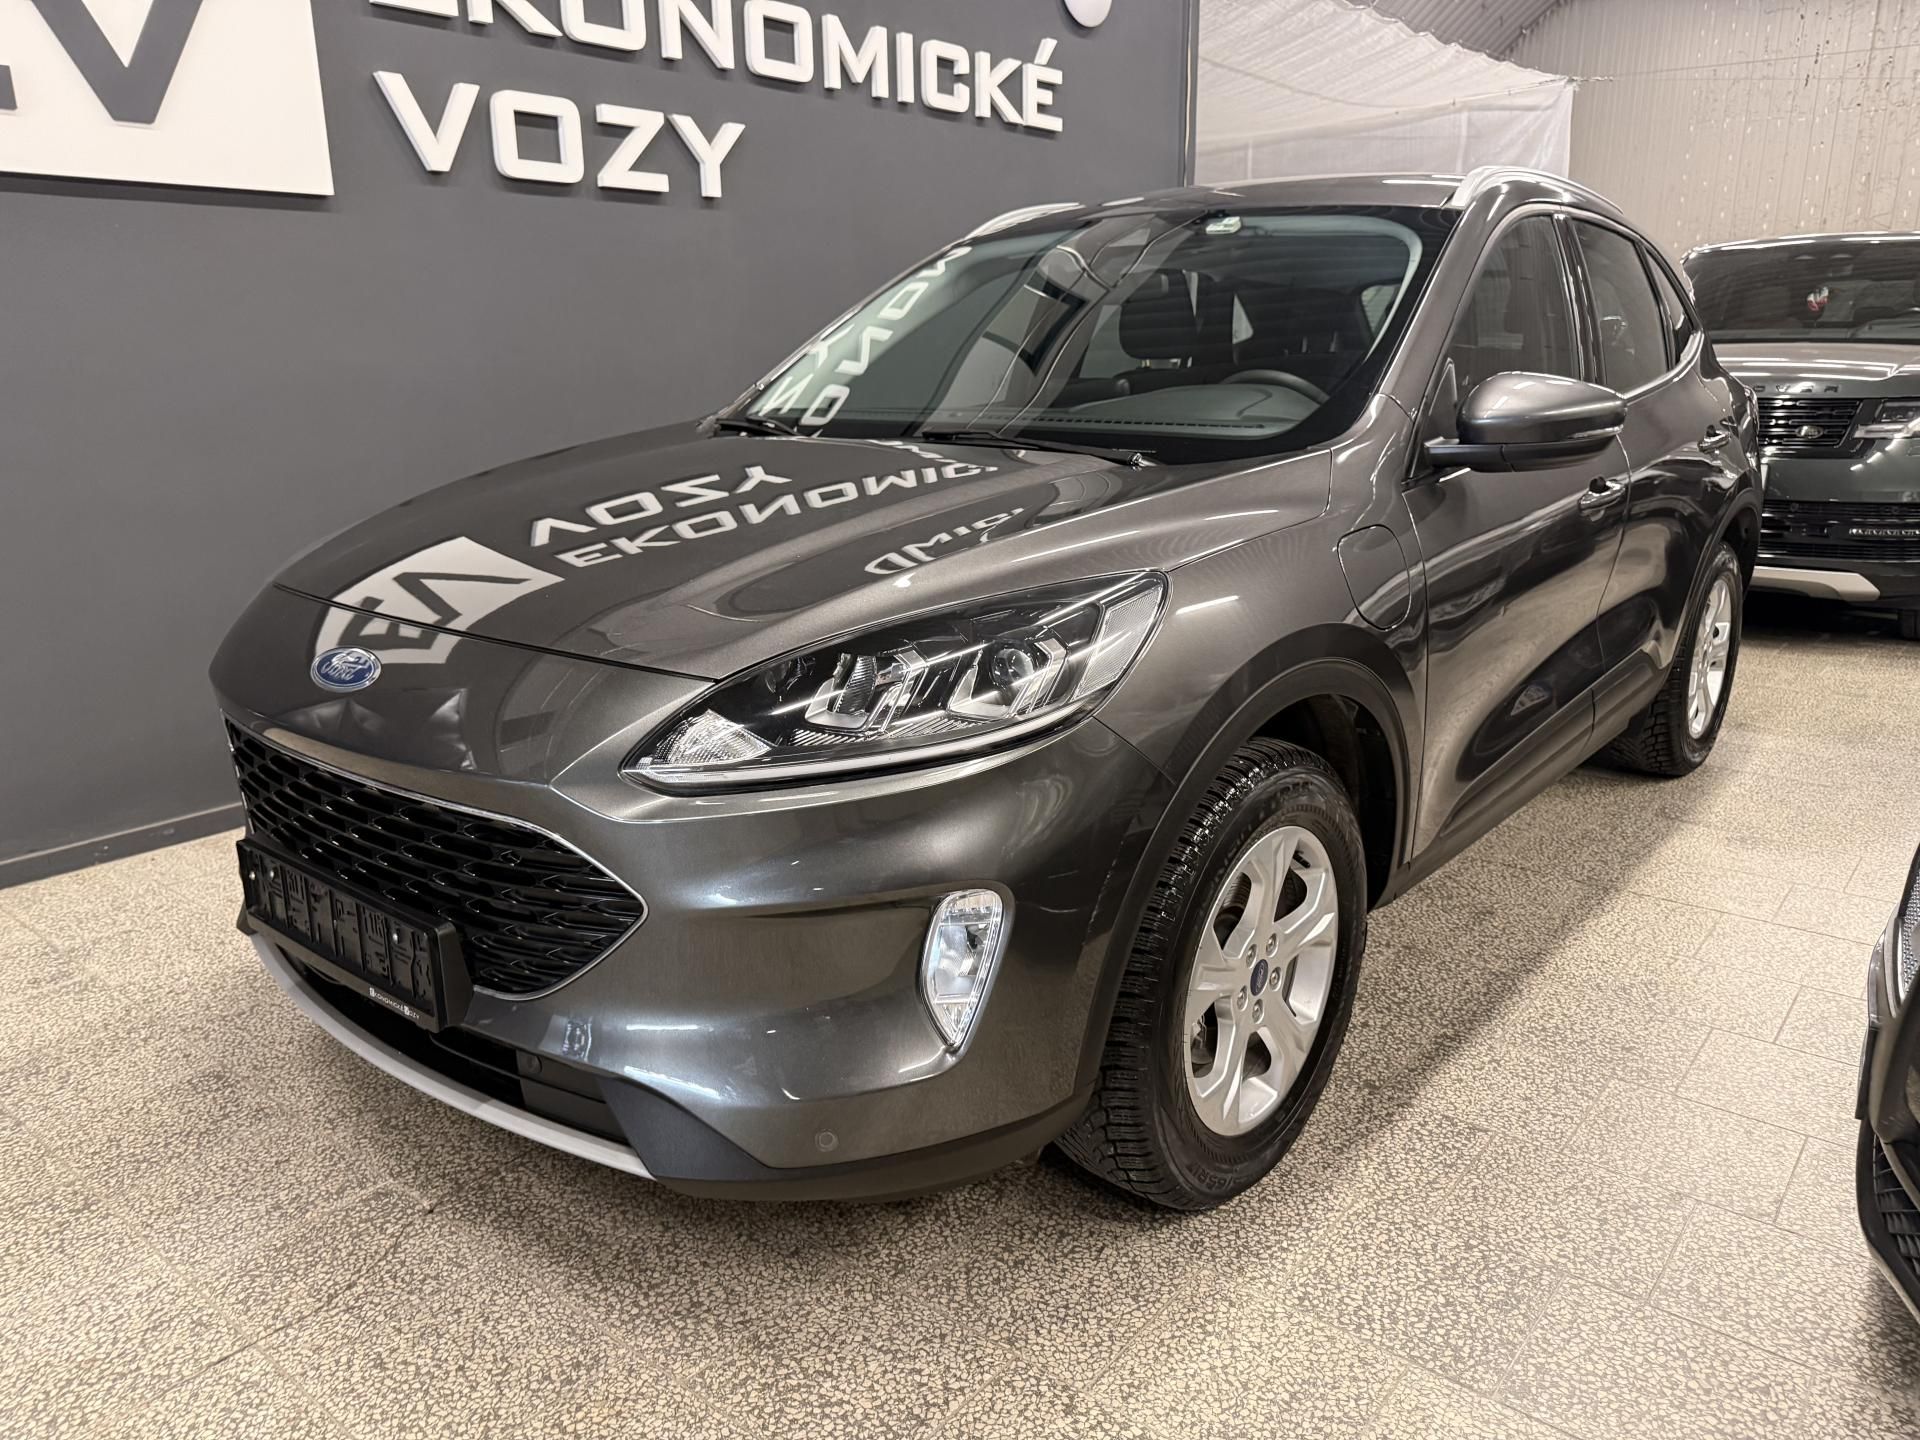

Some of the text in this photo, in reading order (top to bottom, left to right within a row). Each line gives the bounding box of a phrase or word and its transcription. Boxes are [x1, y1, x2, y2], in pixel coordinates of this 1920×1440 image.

[369, 0, 1063, 132] ONOMICKÉ
[372, 70, 746, 199] VOZY
[320, 652, 370, 682] Ford
